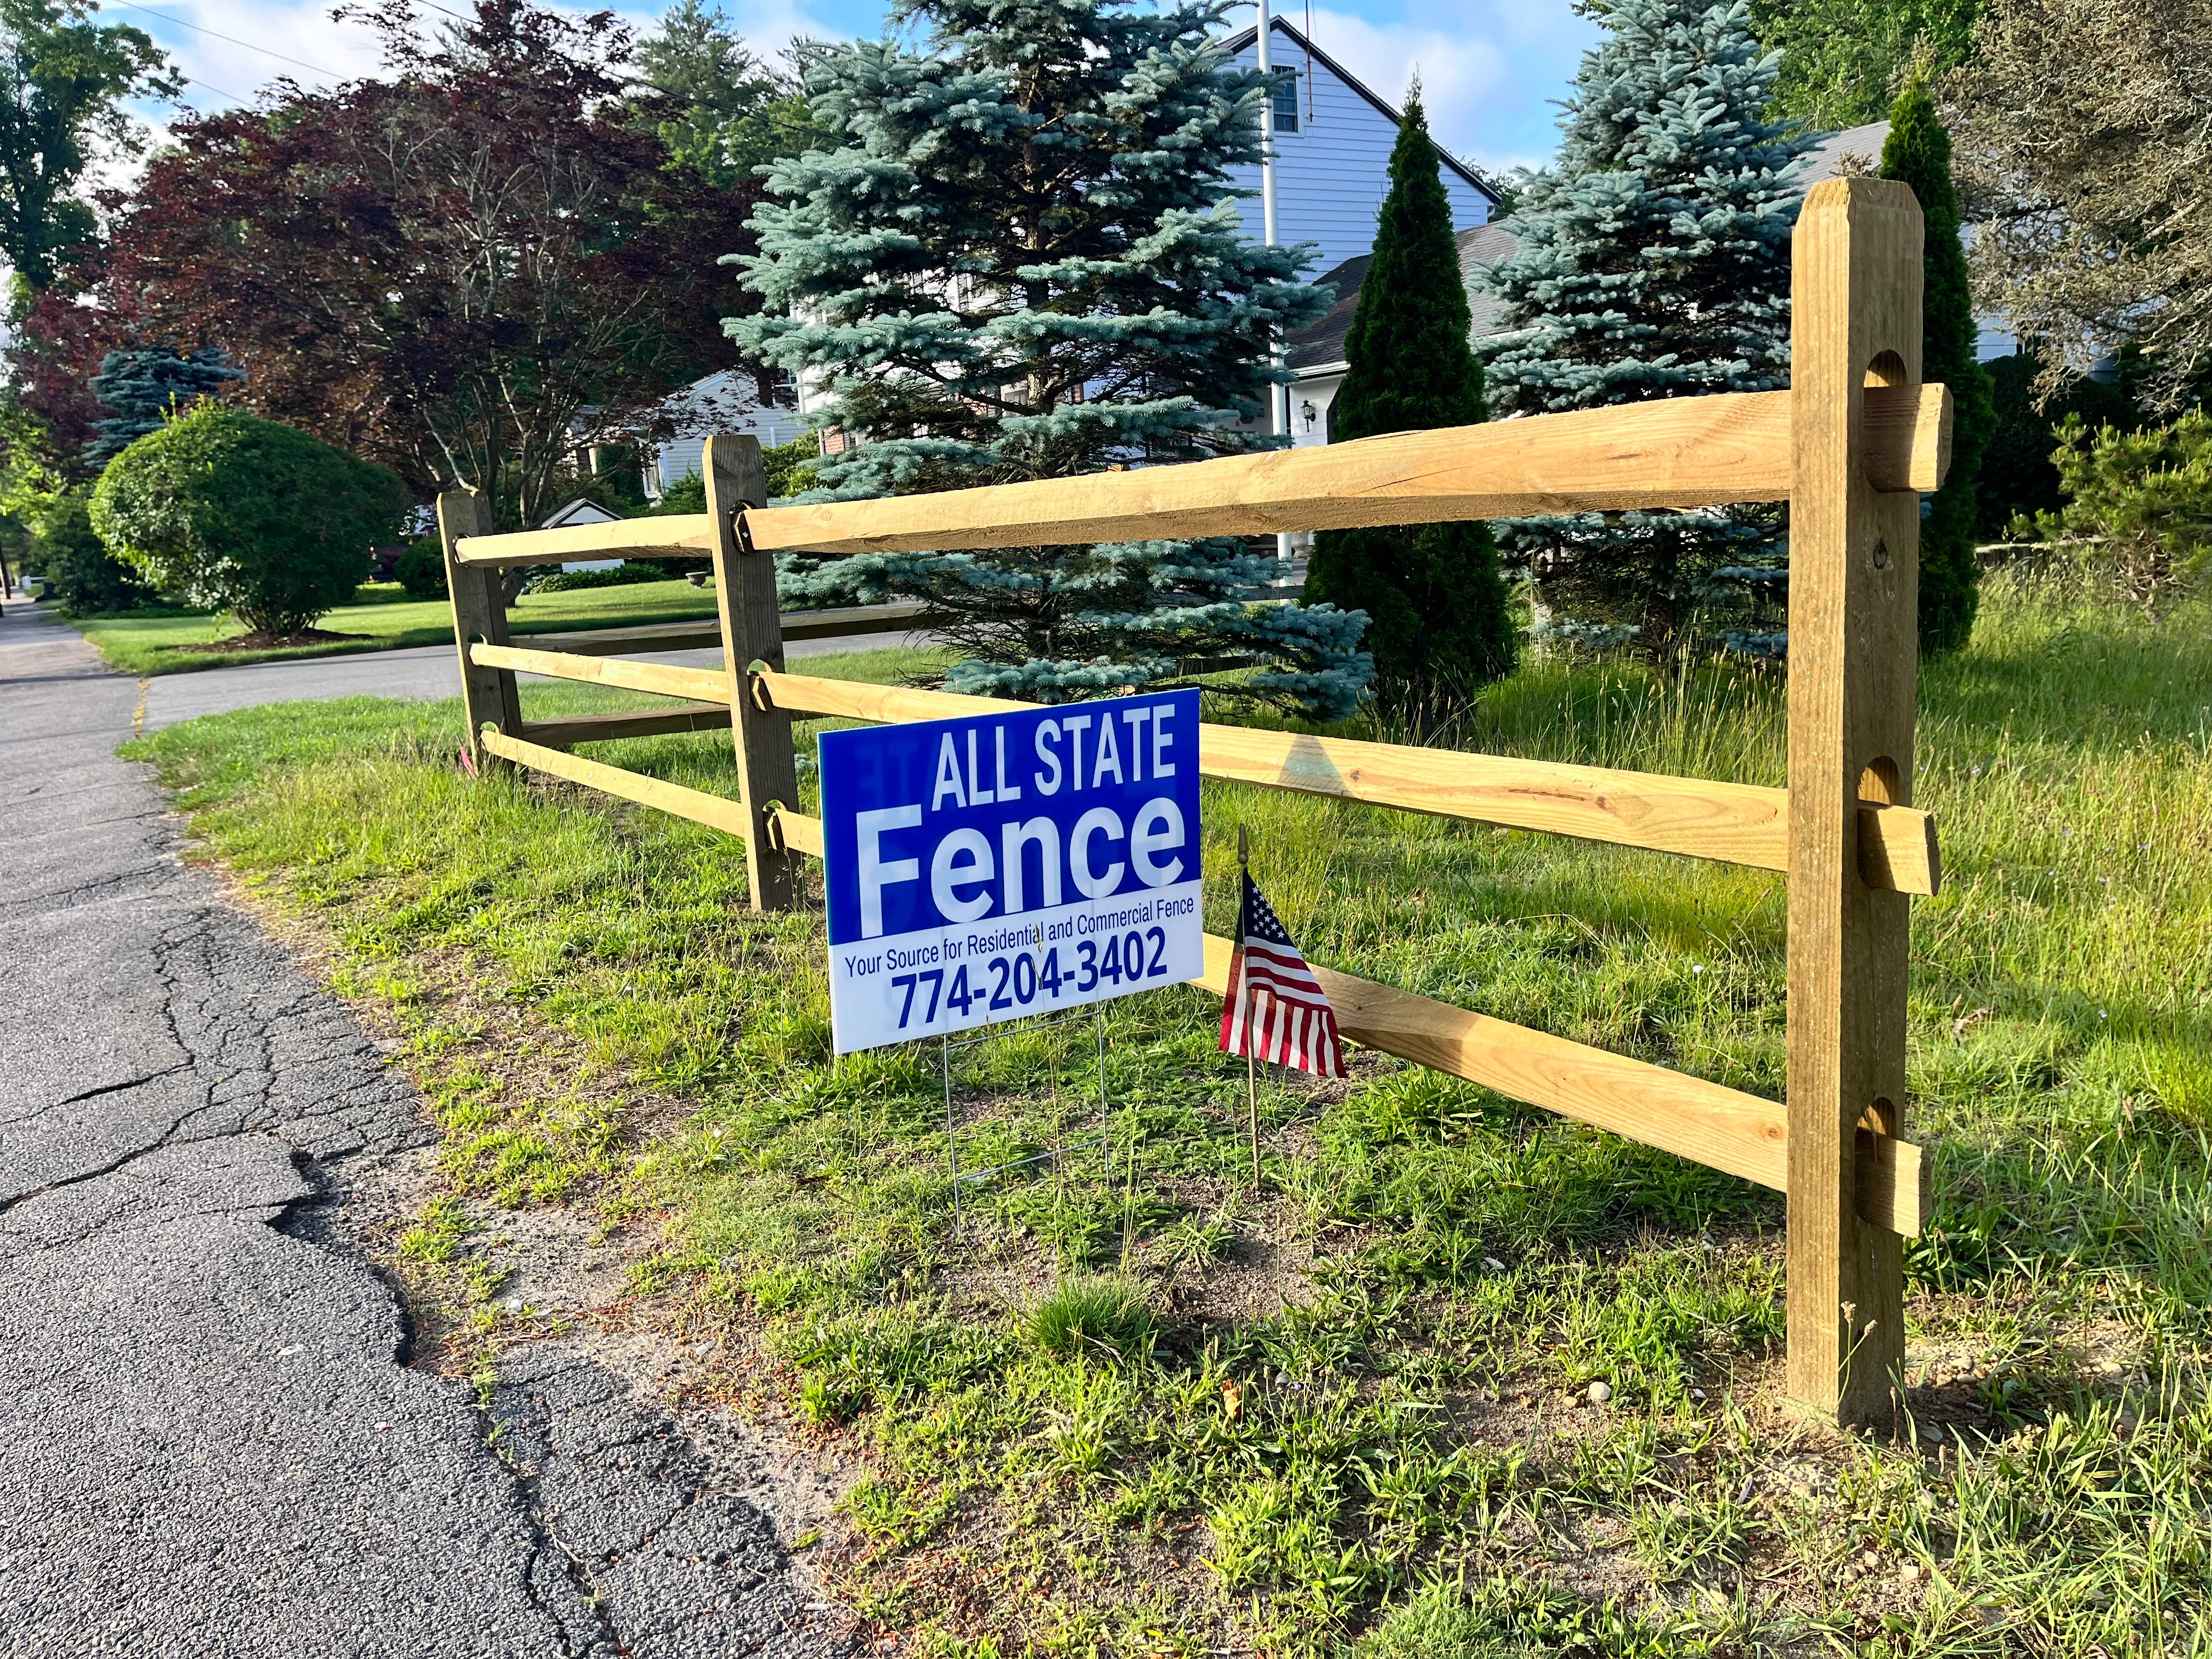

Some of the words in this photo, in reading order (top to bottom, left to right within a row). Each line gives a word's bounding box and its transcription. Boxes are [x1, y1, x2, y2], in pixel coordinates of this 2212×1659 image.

[932, 725, 1020, 811] ALL
[1035, 704, 1175, 796] STATE
[856, 797, 1185, 939] Fence
[845, 955, 882, 978] Your
[887, 946, 939, 970] Source
[943, 938, 962, 960] for
[968, 922, 1043, 956] Residential
[1048, 917, 1073, 941] and
[1077, 901, 1152, 934] Commercial
[1157, 898, 1194, 919] Fence
[891, 926, 1167, 1029] 774-204-3402
